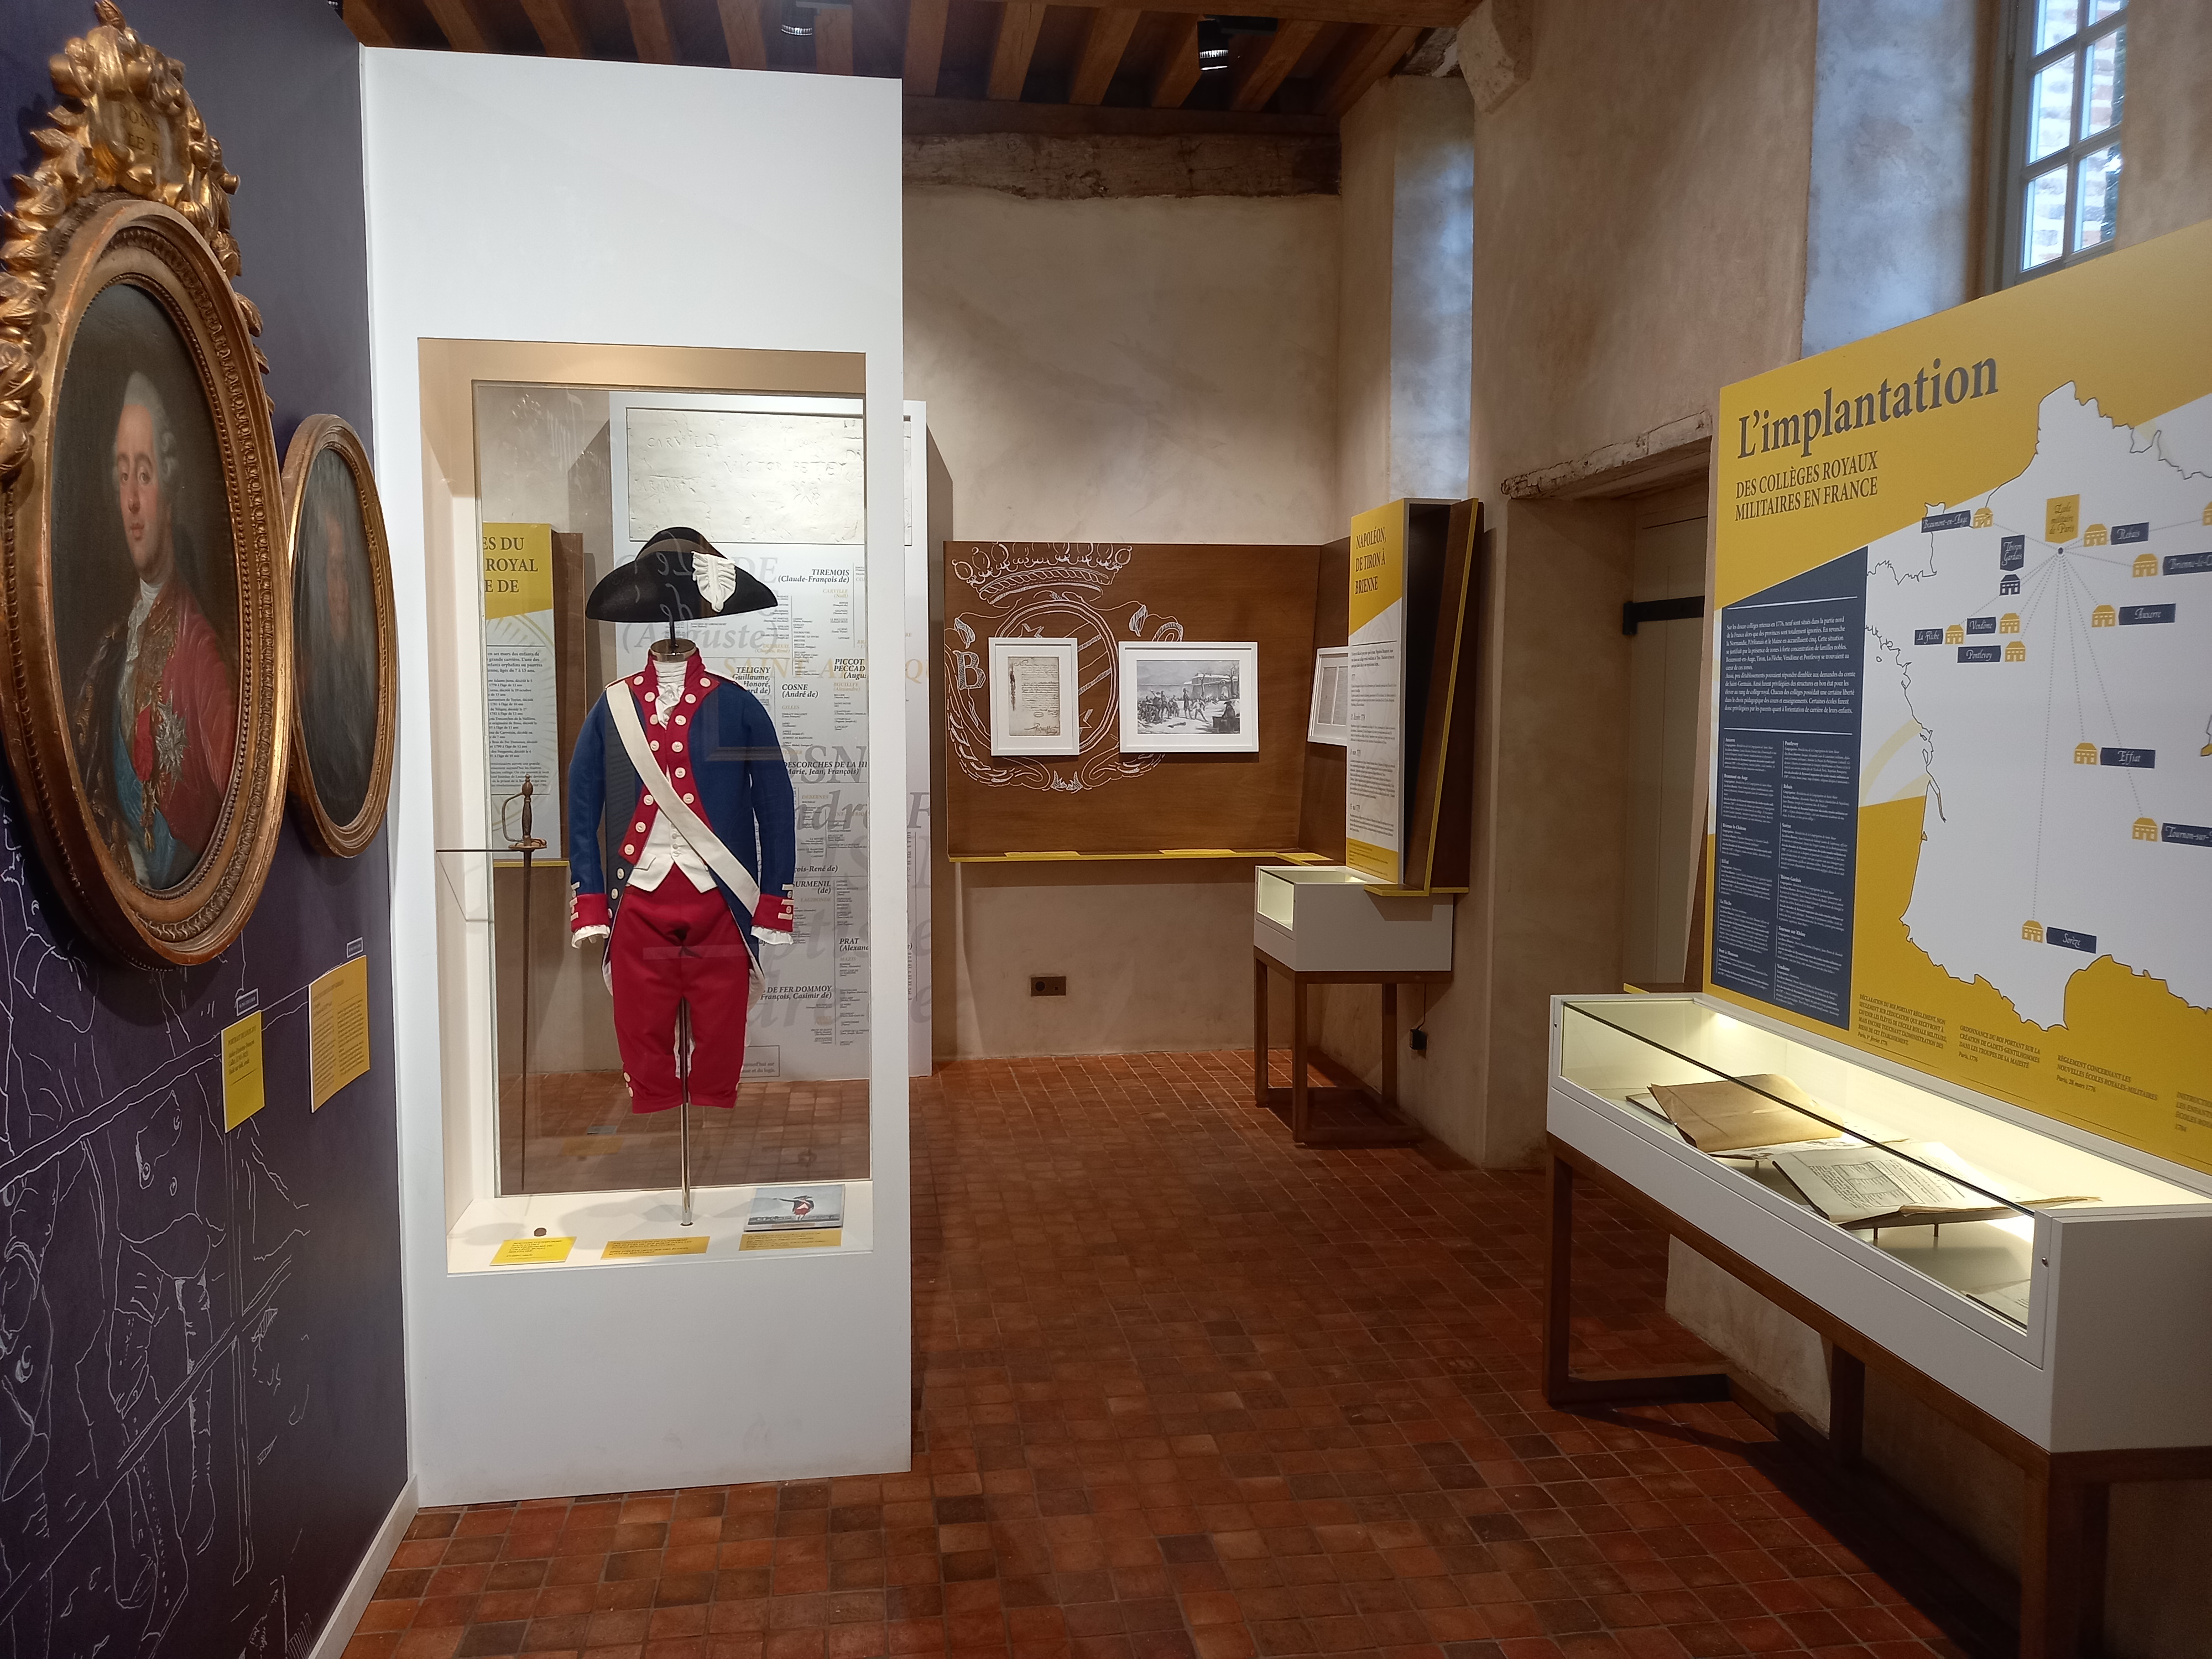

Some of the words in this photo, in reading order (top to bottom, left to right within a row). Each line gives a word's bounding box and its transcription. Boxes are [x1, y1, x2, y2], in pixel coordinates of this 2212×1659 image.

[1736, 478, 1756, 499] DES
[1759, 464, 1819, 493] COLLÈGES
[1822, 451, 1878, 480] ROYAUX
[1735, 492, 1801, 521] MILITAIRES
[1804, 487, 1821, 509] EN
[1823, 476, 1878, 504] FRANCE
[2049, 524, 2055, 534] de
[2058, 523, 2074, 534] Paris
[500, 537, 524, 550] DU
[1356, 526, 1386, 550] NAPOLÉON,
[2004, 541, 2022, 551] Thiron
[486, 558, 538, 572] ROYAL
[1355, 556, 1363, 572] DE
[1364, 551, 1381, 571] TIRON
[1381, 547, 1386, 565] À
[2002, 551, 2022, 566] Gardais
[497, 580, 519, 593] DE
[1355, 576, 1378, 594] BRIENNE
[732, 674, 770, 682] Guillaume,
[952, 650, 987, 691] B
[2117, 750, 2141, 765] Effiat
[821, 992, 832, 1000] de)
[1860, 994, 1883, 1005] DÉCLARATION
[1896, 1005, 1913, 1014] PORTANT
[1859, 1001, 1879, 1012] SEULEMENT
[1918, 1020, 1941, 1031] RECEVRONT
[1868, 1020, 1881, 1028] ENCORE
[1881, 1024, 1901, 1035] TOUCHANT
[1912, 1025, 1926, 1034] ROYALE
[1960, 1025, 1989, 1039] ORDONNANCE
[2004, 1039, 2025, 1050] PORTANT
[1959, 1033, 1981, 1044] CRÉATION
[1987, 1041, 2040, 1063] CADETS-GENTILHOMMES
[1959, 1041, 1970, 1050] DANS
[1979, 1047, 1997, 1058] TROUPES
[2010, 1057, 2030, 1068] MAJESTÉ
[1959, 1051, 1969, 1060] Paris,
[2057, 1064, 2085, 1077] NOUVELLES
[2085, 1072, 2104, 1083] ÉCOLES
[2058, 1055, 2087, 1069] RÈGLEMENT
[2087, 1064, 2122, 1079] CONCERNANT
[2057, 1075, 2068, 1084] Paris,
